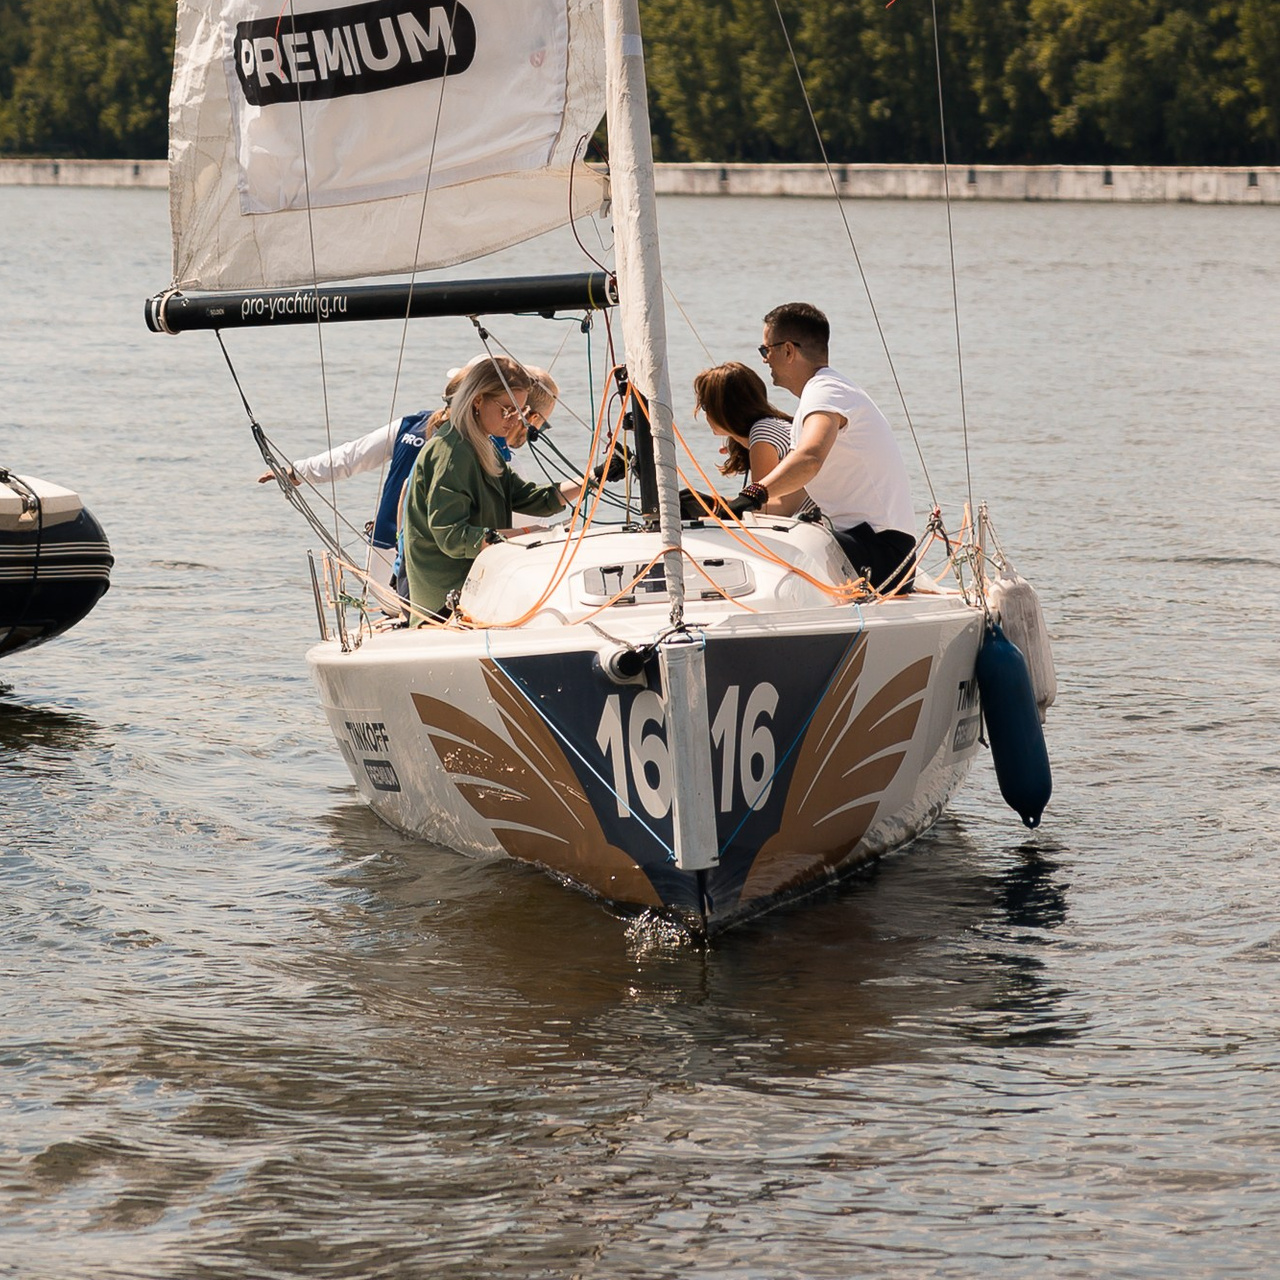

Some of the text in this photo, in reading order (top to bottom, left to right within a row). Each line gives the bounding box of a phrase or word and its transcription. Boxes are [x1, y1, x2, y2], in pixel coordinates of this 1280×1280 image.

[241, 291, 348, 320] pro-yachting.ru
[595, 690, 672, 819] 16
[710, 681, 780, 813] 16
